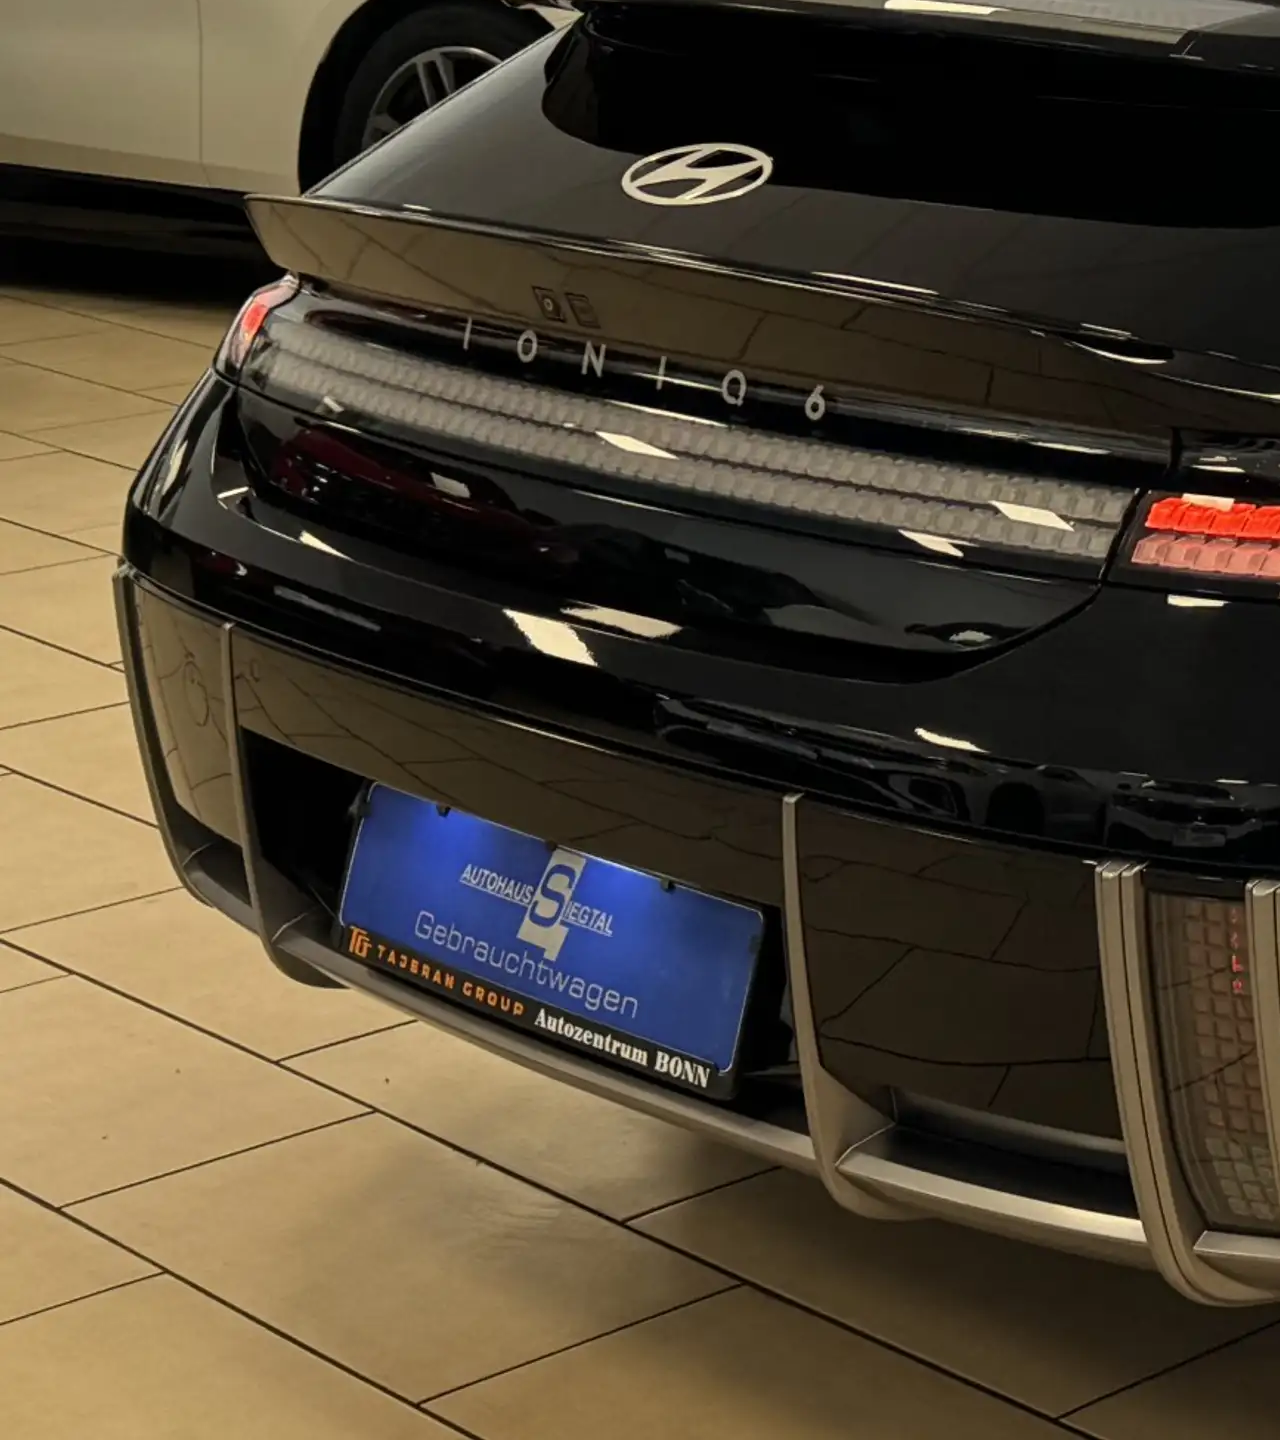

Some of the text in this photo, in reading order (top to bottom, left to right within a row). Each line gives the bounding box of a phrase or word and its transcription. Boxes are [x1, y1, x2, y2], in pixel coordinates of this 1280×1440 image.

[463, 316, 826, 422] IONIQ 6
[460, 863, 534, 906] AUTOHAUS
[415, 910, 638, 1017] Gebrauchtwagen
[462, 981, 524, 1015] GROUP
[534, 1008, 648, 1067] Autozentrum
[654, 1054, 710, 1088] BONN
